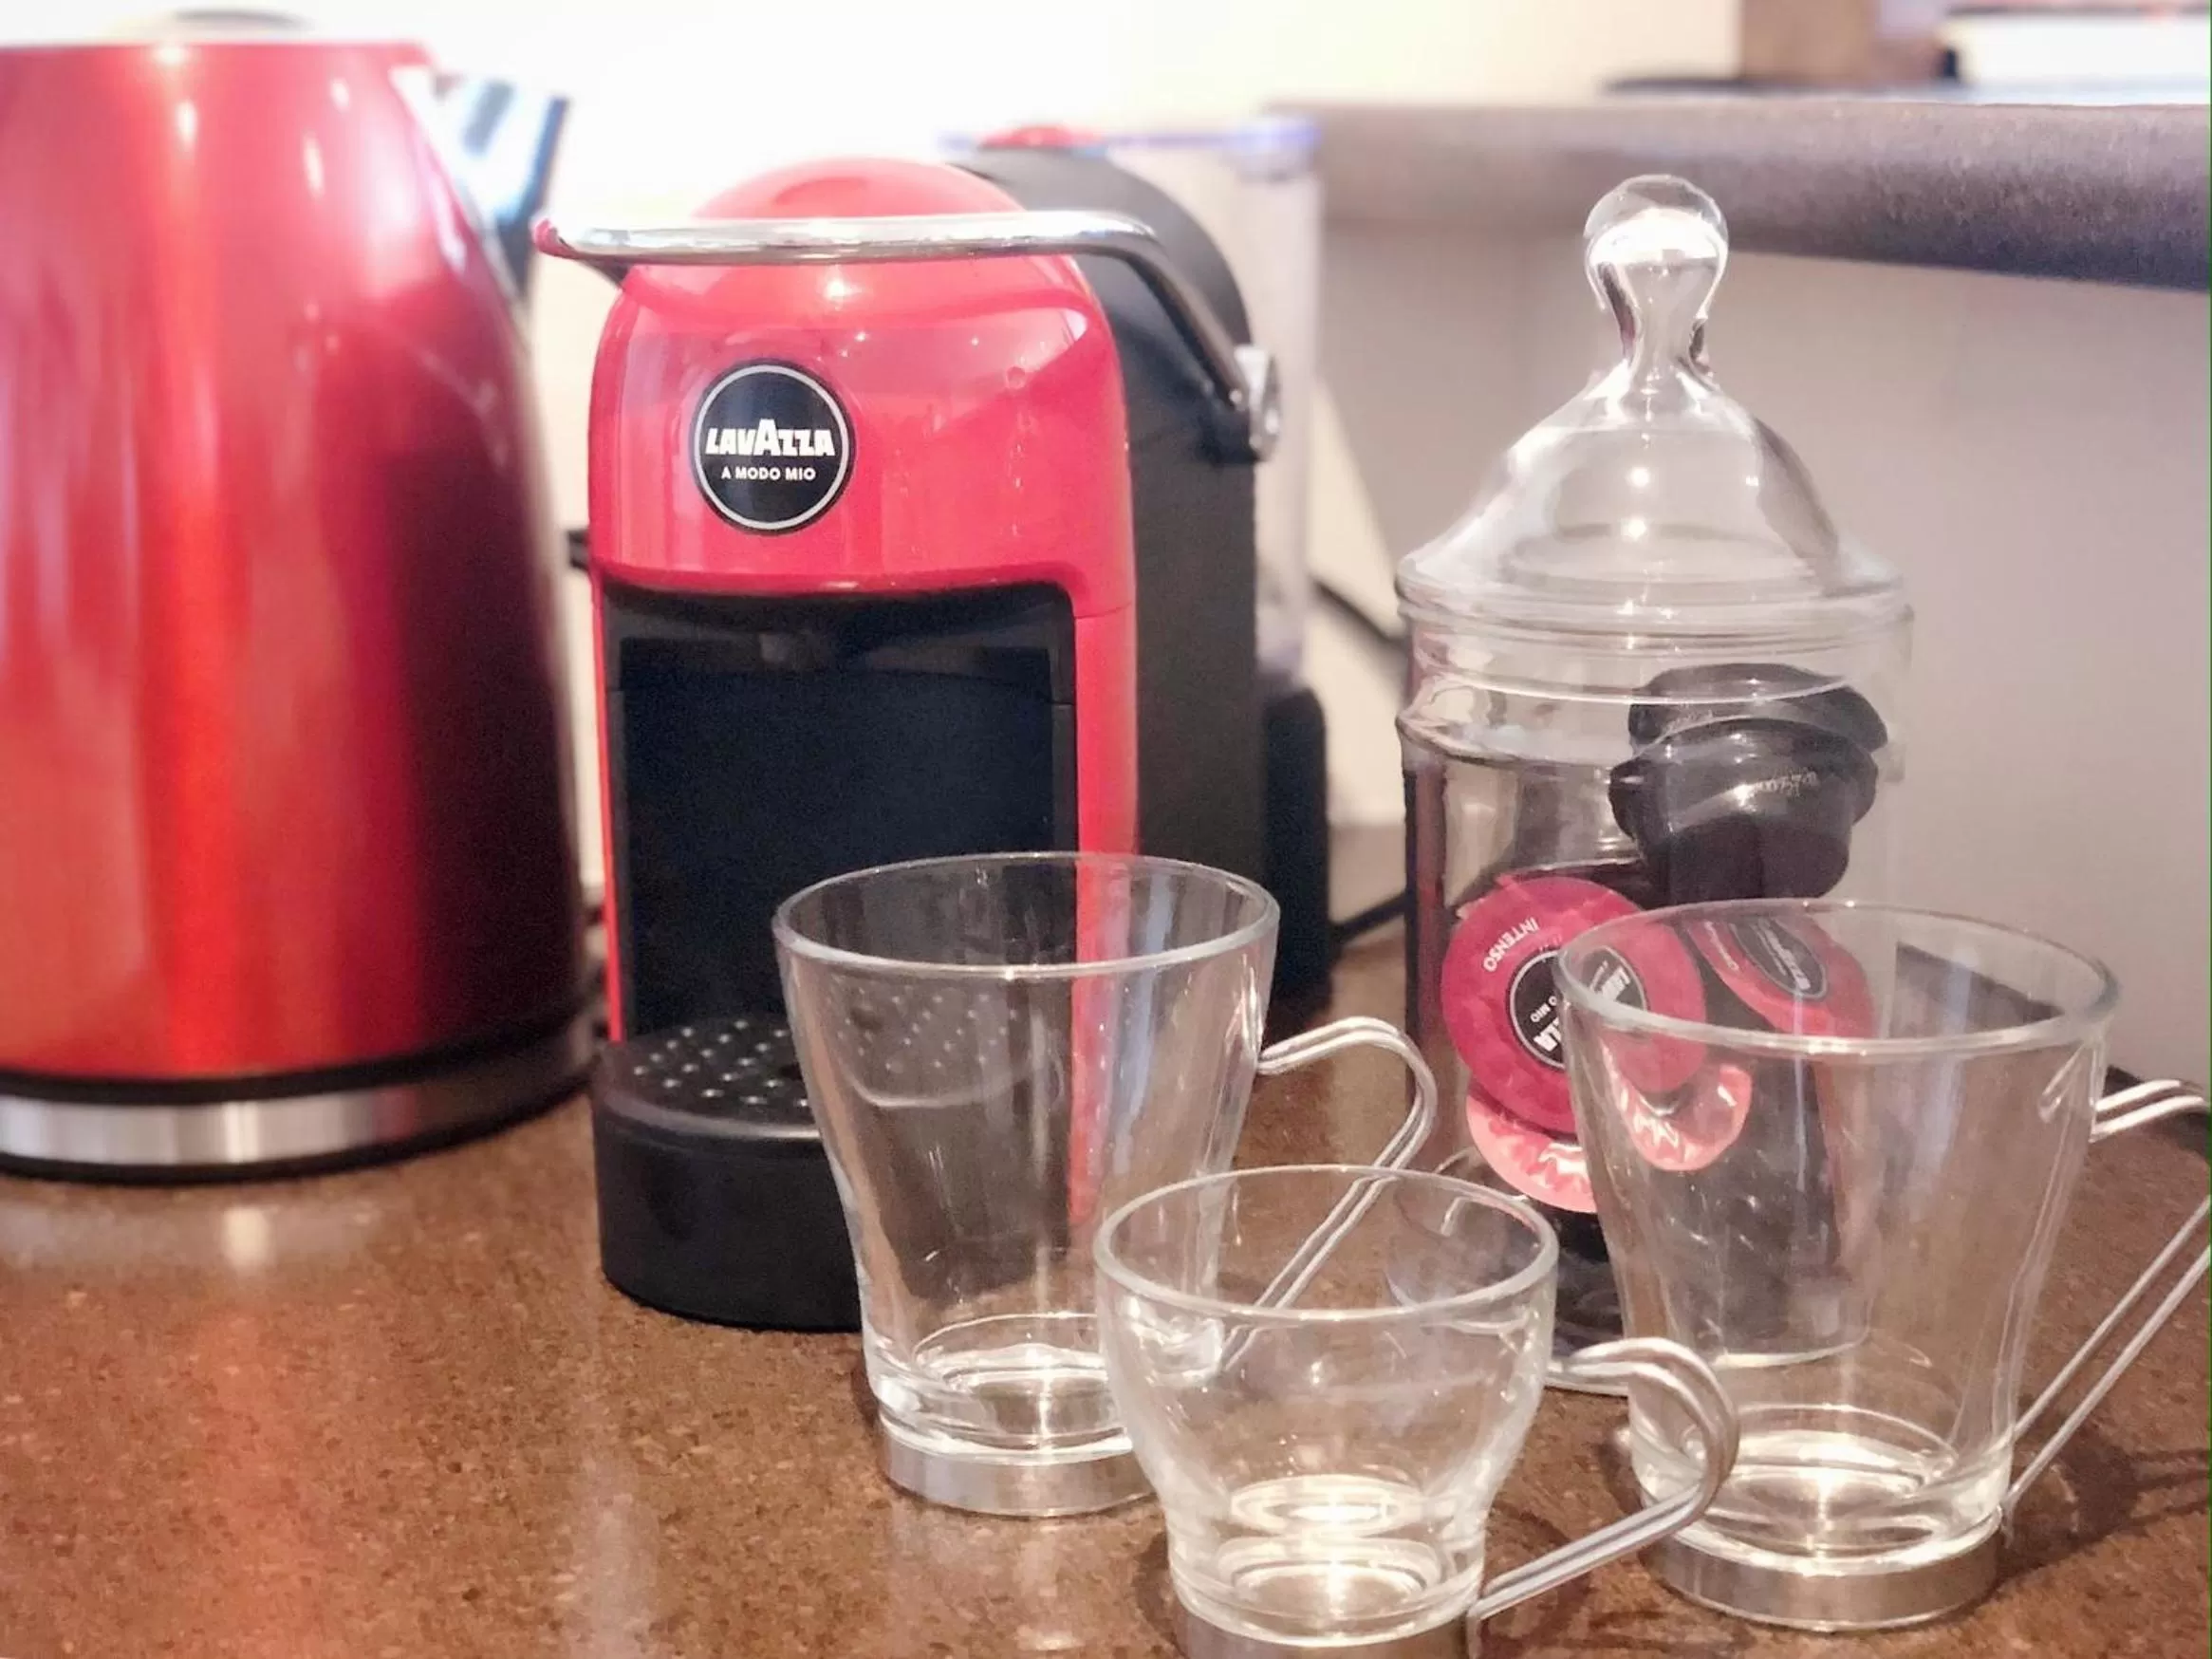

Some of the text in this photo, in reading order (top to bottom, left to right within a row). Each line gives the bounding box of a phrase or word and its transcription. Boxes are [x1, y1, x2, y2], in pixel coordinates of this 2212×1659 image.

[705, 419, 835, 457] LAVAZZA
[720, 466, 817, 481] A MODO MIO
[1482, 917, 1541, 972] INTENSO
